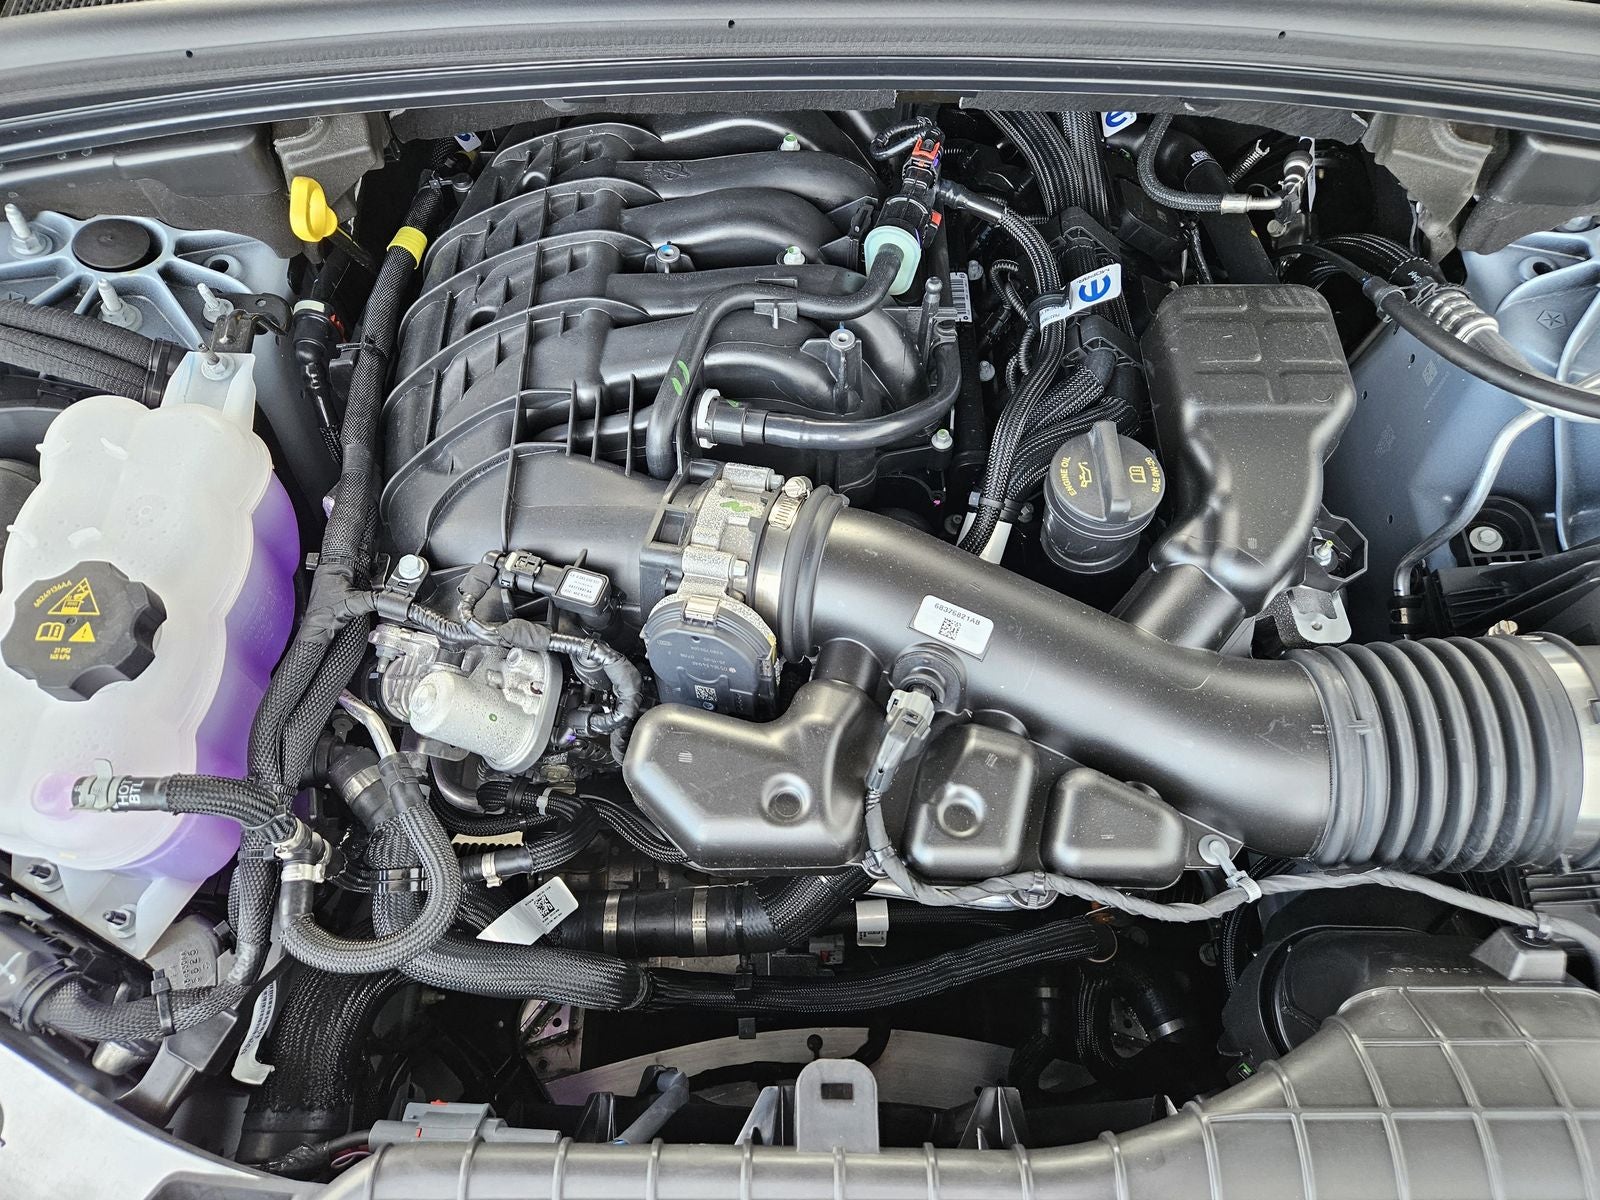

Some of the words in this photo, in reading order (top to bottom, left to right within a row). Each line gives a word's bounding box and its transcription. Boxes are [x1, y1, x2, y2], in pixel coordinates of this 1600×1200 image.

[1061, 456, 1071, 468] OIL
[1060, 468, 1077, 496] ENGINE
[1151, 477, 1161, 493] SAE
[118, 779, 132, 806] HOT
